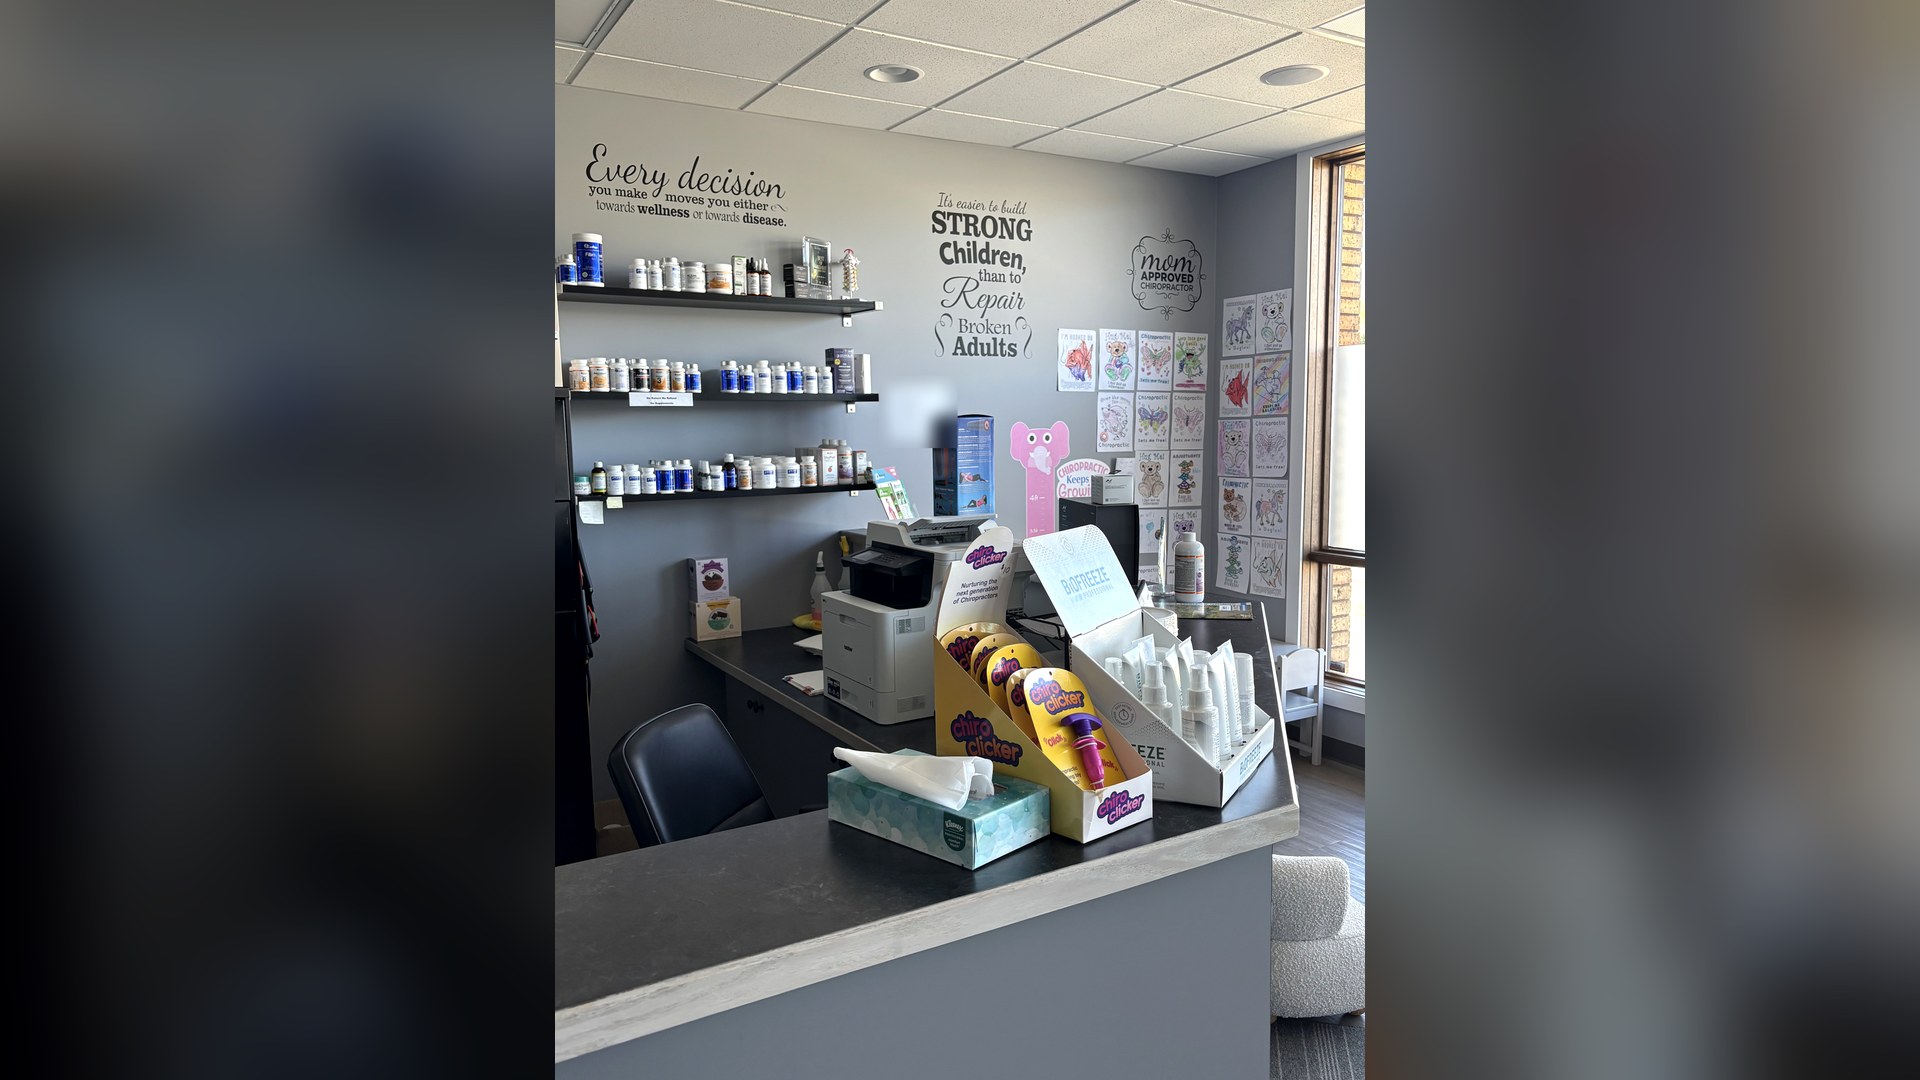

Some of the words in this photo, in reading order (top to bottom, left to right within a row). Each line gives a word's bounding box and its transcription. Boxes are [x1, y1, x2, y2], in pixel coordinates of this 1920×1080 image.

[585, 143, 670, 198] Every
[678, 156, 786, 199] decision
[588, 185, 612, 197] you
[615, 188, 648, 200] make
[665, 193, 705, 205] moves
[707, 198, 730, 209] you
[734, 198, 769, 211] either
[937, 192, 953, 208] It's
[957, 200, 986, 211] easier
[989, 200, 999, 212] to
[1001, 200, 1027, 215] build
[596, 200, 635, 214] towards
[637, 204, 690, 218] wellness
[693, 210, 703, 219] or
[705, 210, 740, 223] towards
[743, 213, 787, 227] disease.
[931, 210, 1033, 242] STRONG
[939, 240, 1027, 275] Children,
[1141, 254, 1196, 273] mom
[979, 269, 1006, 283] than
[1009, 271, 1022, 284] to
[1141, 271, 1194, 283] APPROVED
[1141, 282, 1194, 292] CHIROPRACTOR
[941, 276, 1025, 318] Repair
[958, 318, 1012, 335] Broken
[952, 336, 1018, 358] Adults
[1058, 461, 1109, 478] CHIROPRACTIC
[1067, 475, 1089, 486] Keeps
[1058, 483, 1091, 498] Growi
[966, 546, 993, 563] chiro
[973, 551, 1006, 569] clicker
[961, 580, 988, 589] Nurturing
[969, 585, 999, 596] generation
[960, 593, 998, 604] Chiropractors
[1046, 692, 1082, 712] clicker
[953, 712, 992, 738] chiro
[967, 736, 1021, 761] clicker
[1099, 791, 1128, 815] chiro
[1109, 796, 1143, 822] clicker
